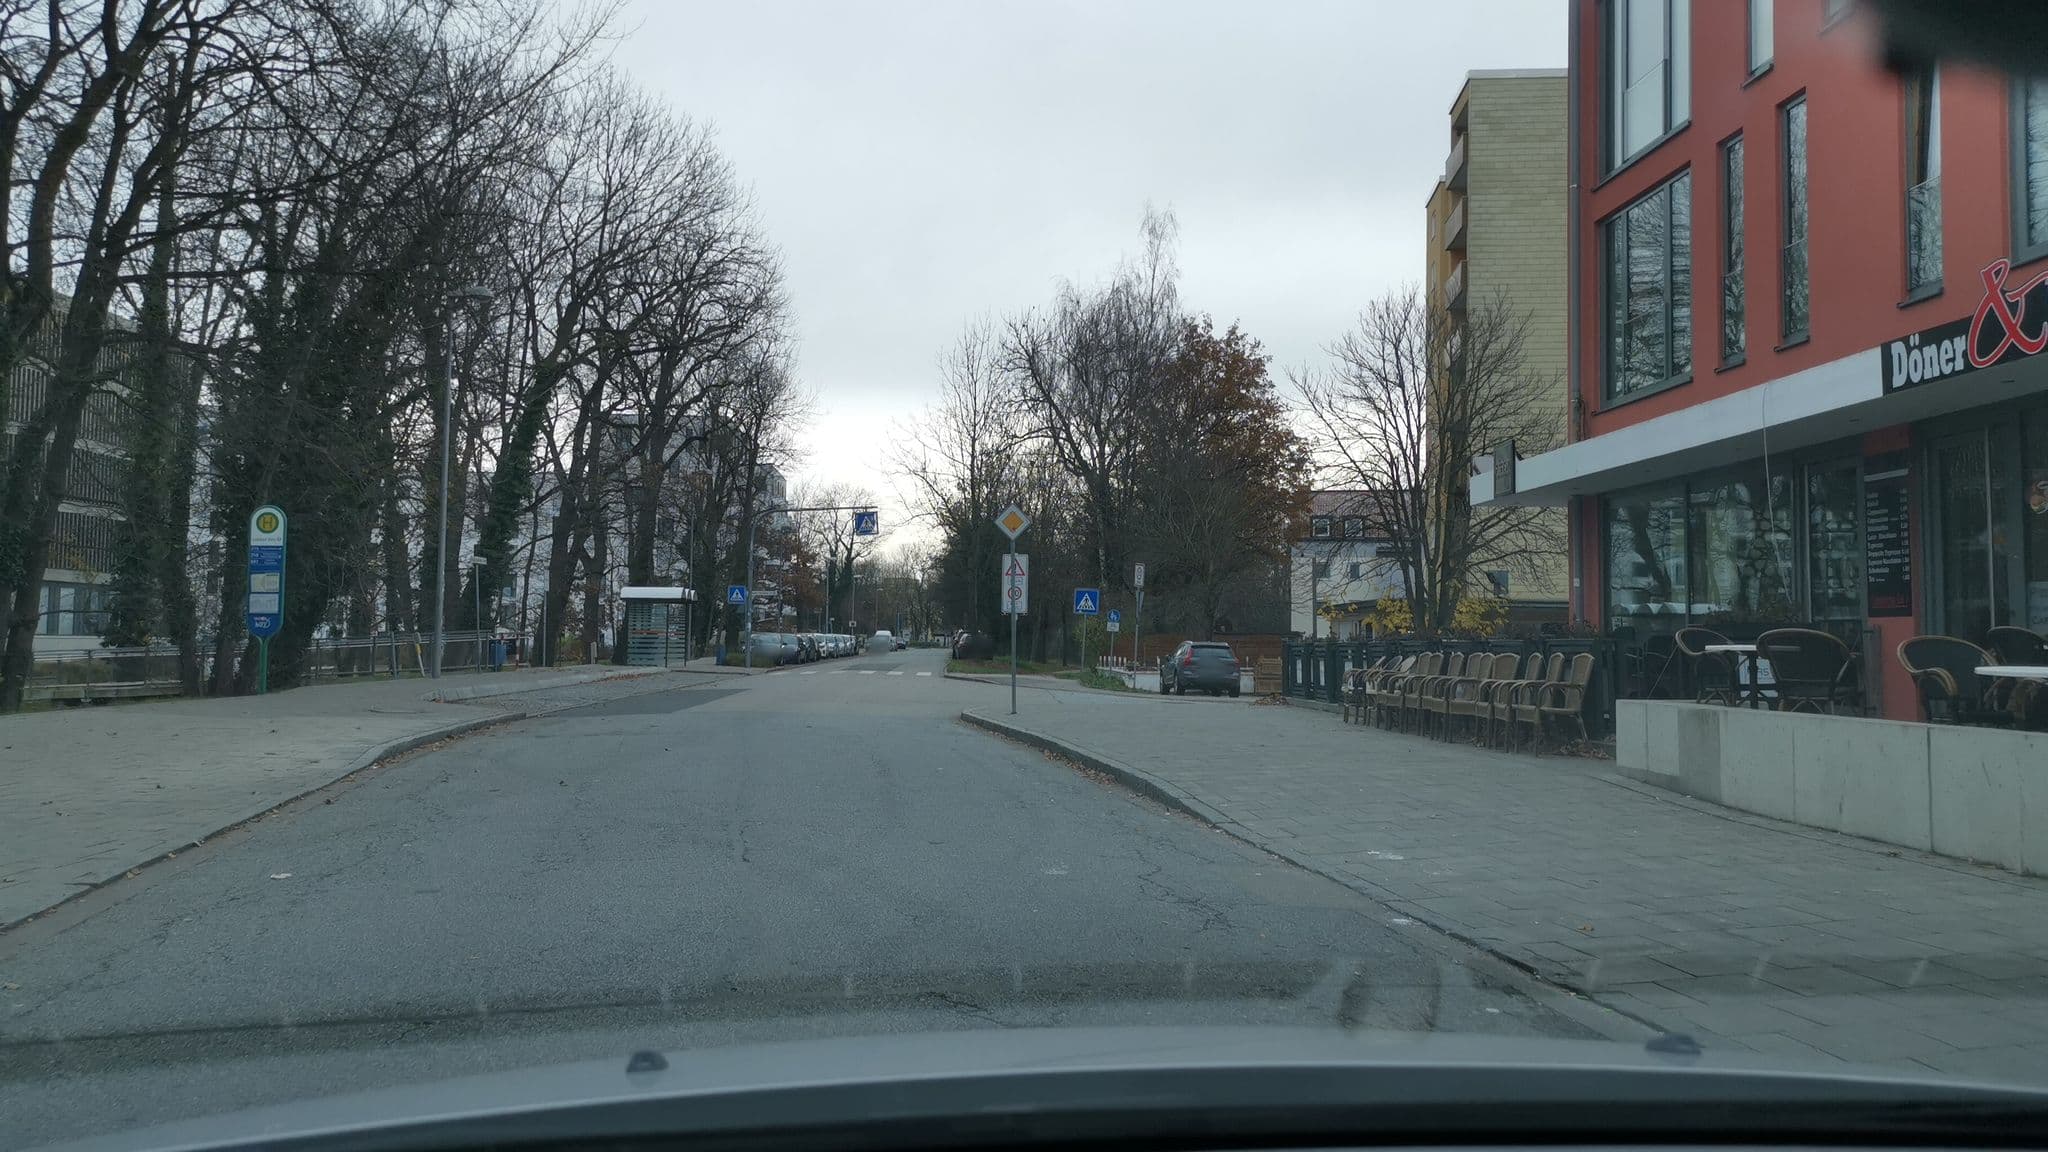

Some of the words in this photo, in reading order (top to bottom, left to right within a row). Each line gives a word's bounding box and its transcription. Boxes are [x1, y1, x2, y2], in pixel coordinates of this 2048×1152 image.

[1890, 333, 1966, 388] Döner
[1968, 258, 2048, 368] &
[262, 515, 273, 529] H
